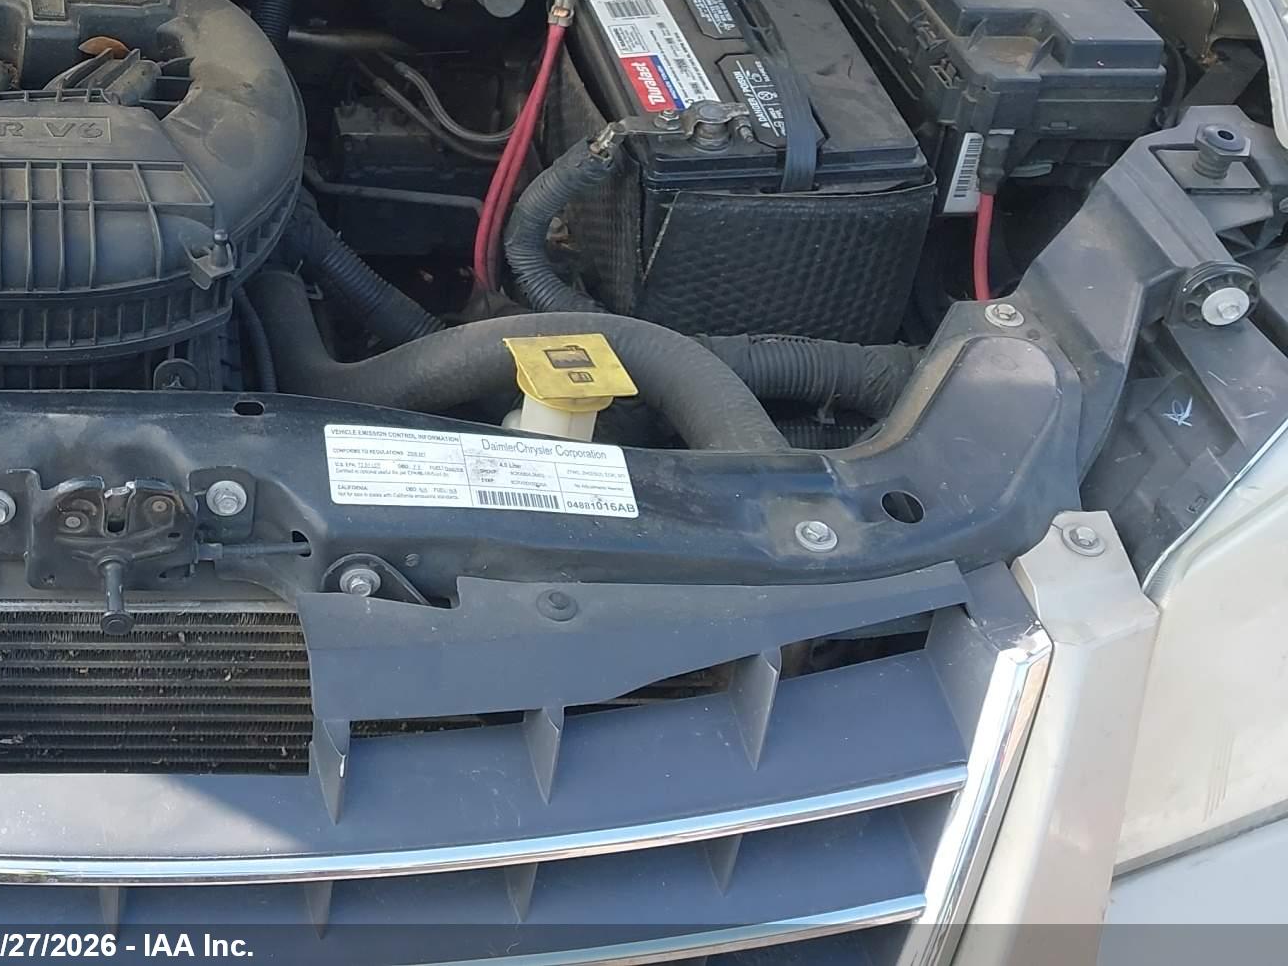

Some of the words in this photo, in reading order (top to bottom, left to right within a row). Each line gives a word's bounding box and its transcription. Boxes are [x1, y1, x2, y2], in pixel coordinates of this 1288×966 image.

[630, 61, 667, 106] Duralast
[732, 70, 752, 93] POISON
[45, 121, 104, 139] V6
[330, 428, 357, 436] VEHICLE
[481, 438, 554, 456] DaimlerChrysler
[555, 444, 608, 460] Corporation
